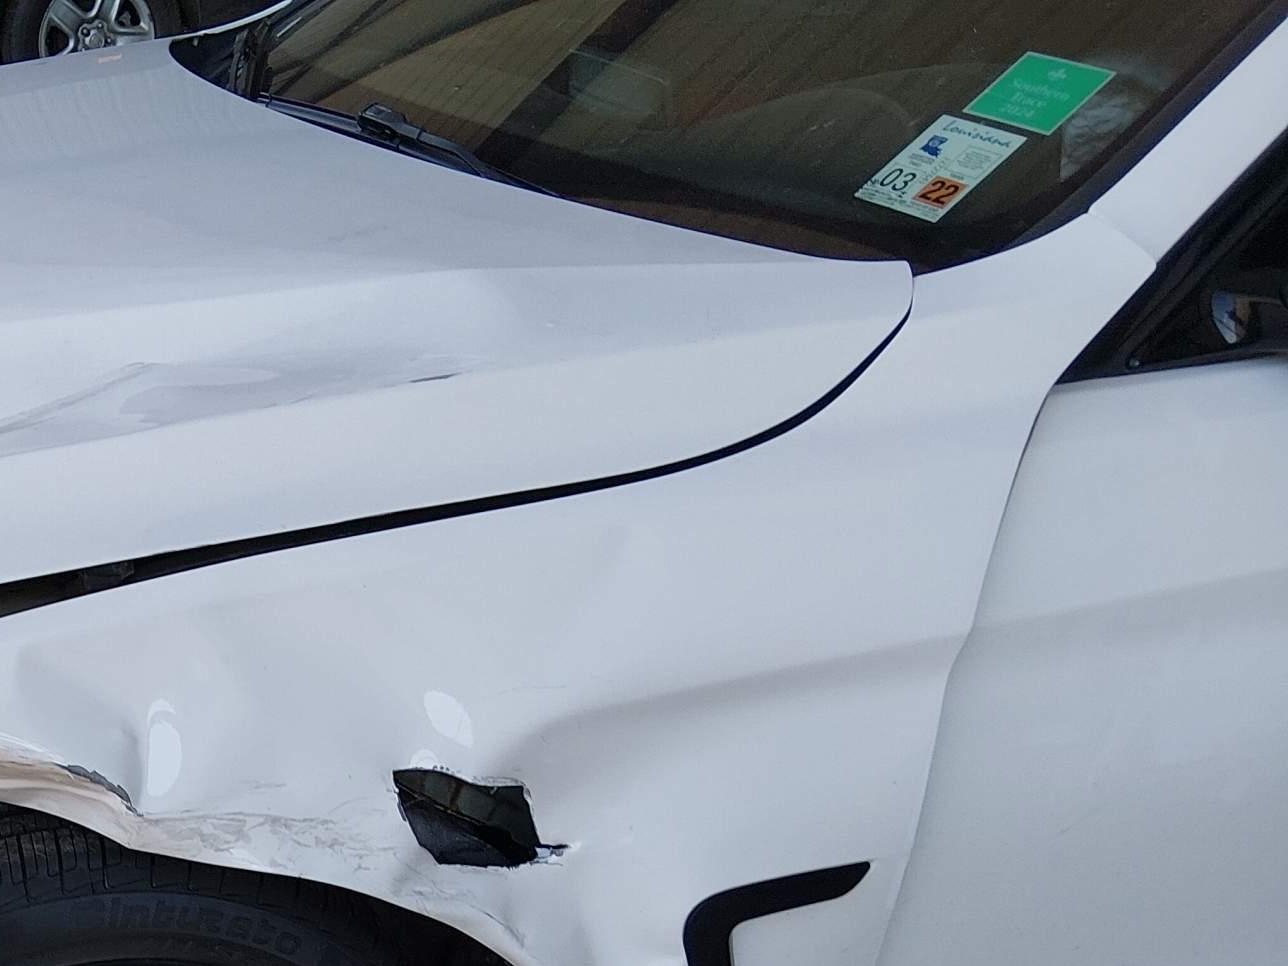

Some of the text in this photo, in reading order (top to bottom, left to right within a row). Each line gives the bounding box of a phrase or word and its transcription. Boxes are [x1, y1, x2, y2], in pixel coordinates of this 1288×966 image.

[941, 119, 1012, 149] Louisiana
[880, 168, 917, 192] 03
[919, 180, 960, 205] 22
